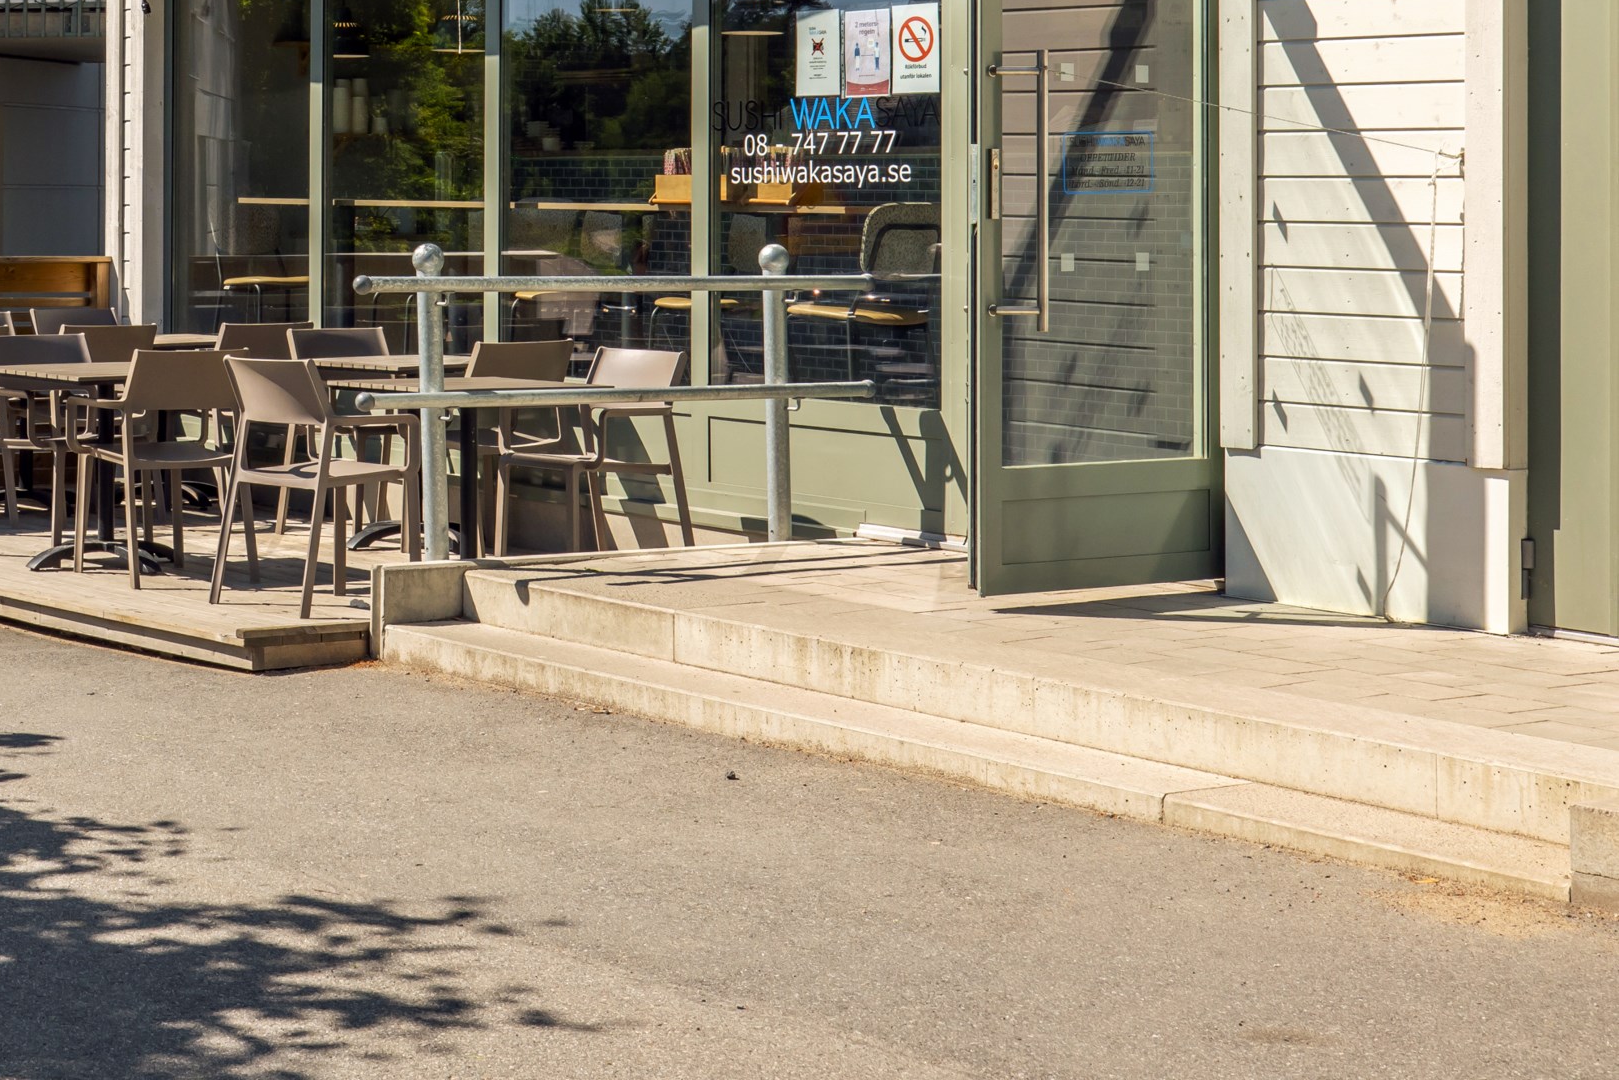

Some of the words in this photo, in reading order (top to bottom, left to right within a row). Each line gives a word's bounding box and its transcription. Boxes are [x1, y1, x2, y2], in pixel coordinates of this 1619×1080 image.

[712, 99, 782, 131] SUSHI
[744, 134, 768, 156] 08
[791, 133, 829, 156] 747
[836, 131, 862, 155] 77
[870, 130, 897, 154] 77
[731, 160, 911, 188] sushiwakasaya.se
